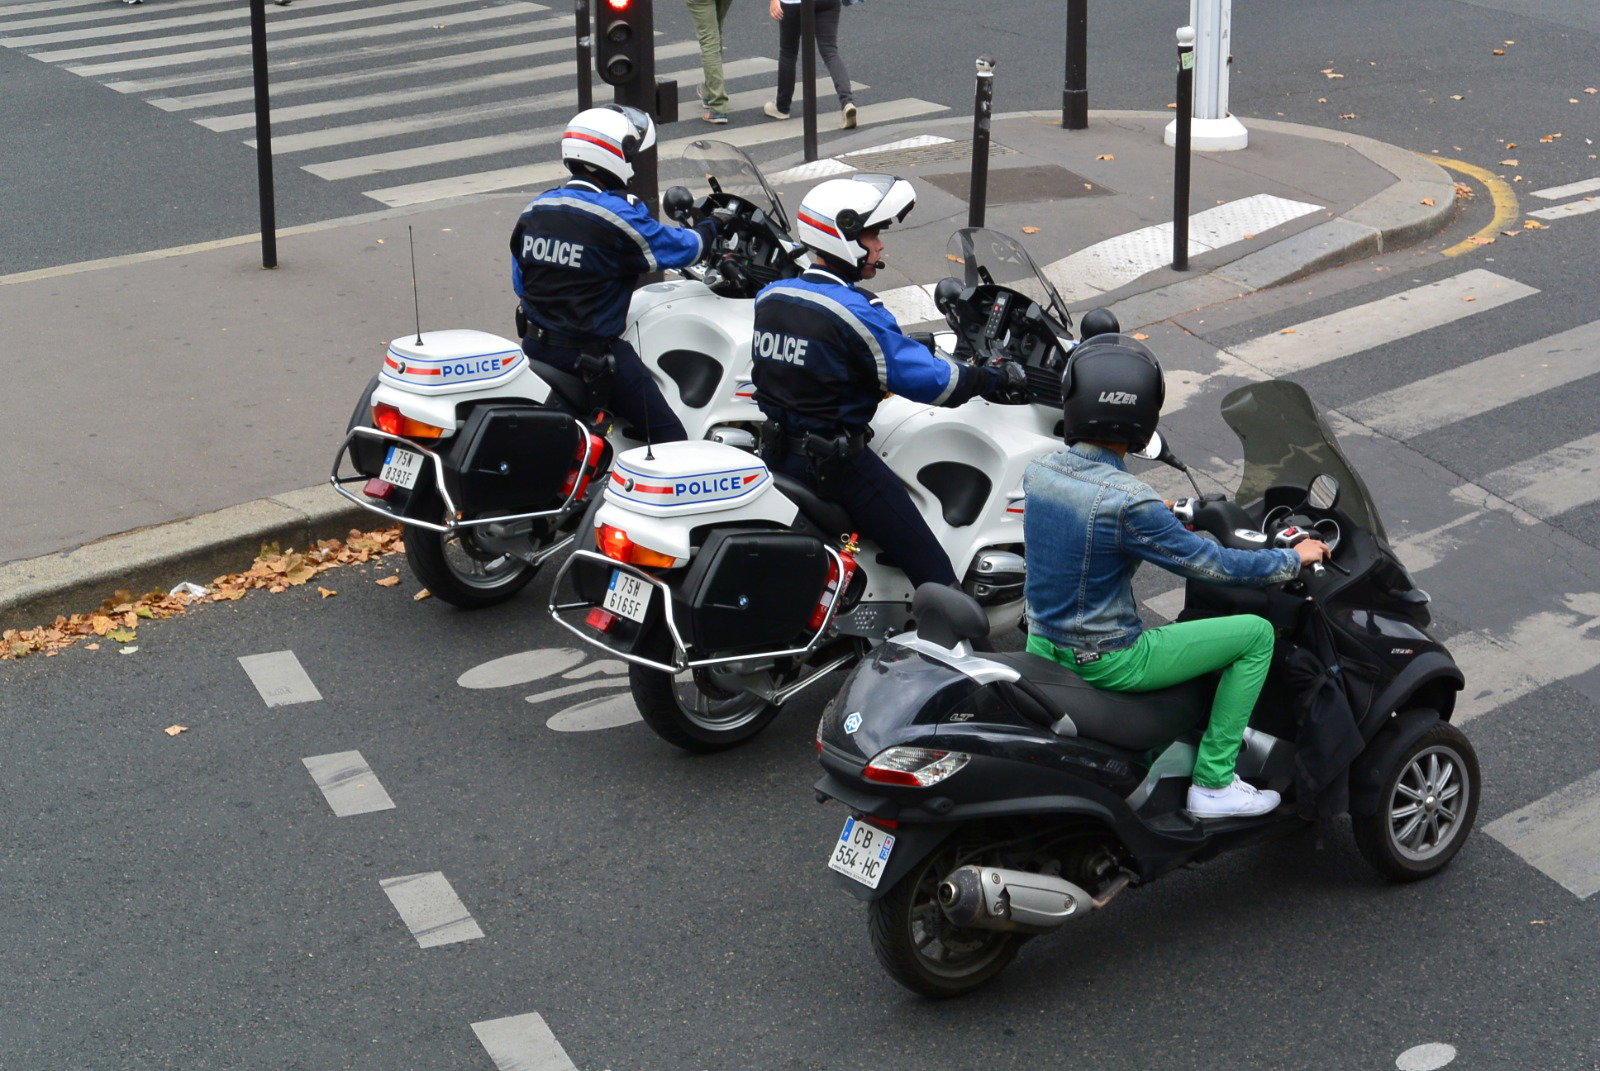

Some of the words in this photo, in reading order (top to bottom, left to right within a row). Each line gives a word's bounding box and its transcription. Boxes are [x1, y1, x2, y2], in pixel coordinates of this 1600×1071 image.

[522, 235, 584, 268] POLICE
[754, 330, 809, 366] POLICE
[442, 359, 501, 378] POLICE
[1098, 391, 1138, 405] LAZER
[384, 466, 412, 486] 8393F
[675, 476, 742, 497] POLICE
[609, 592, 642, 618] 6165F
